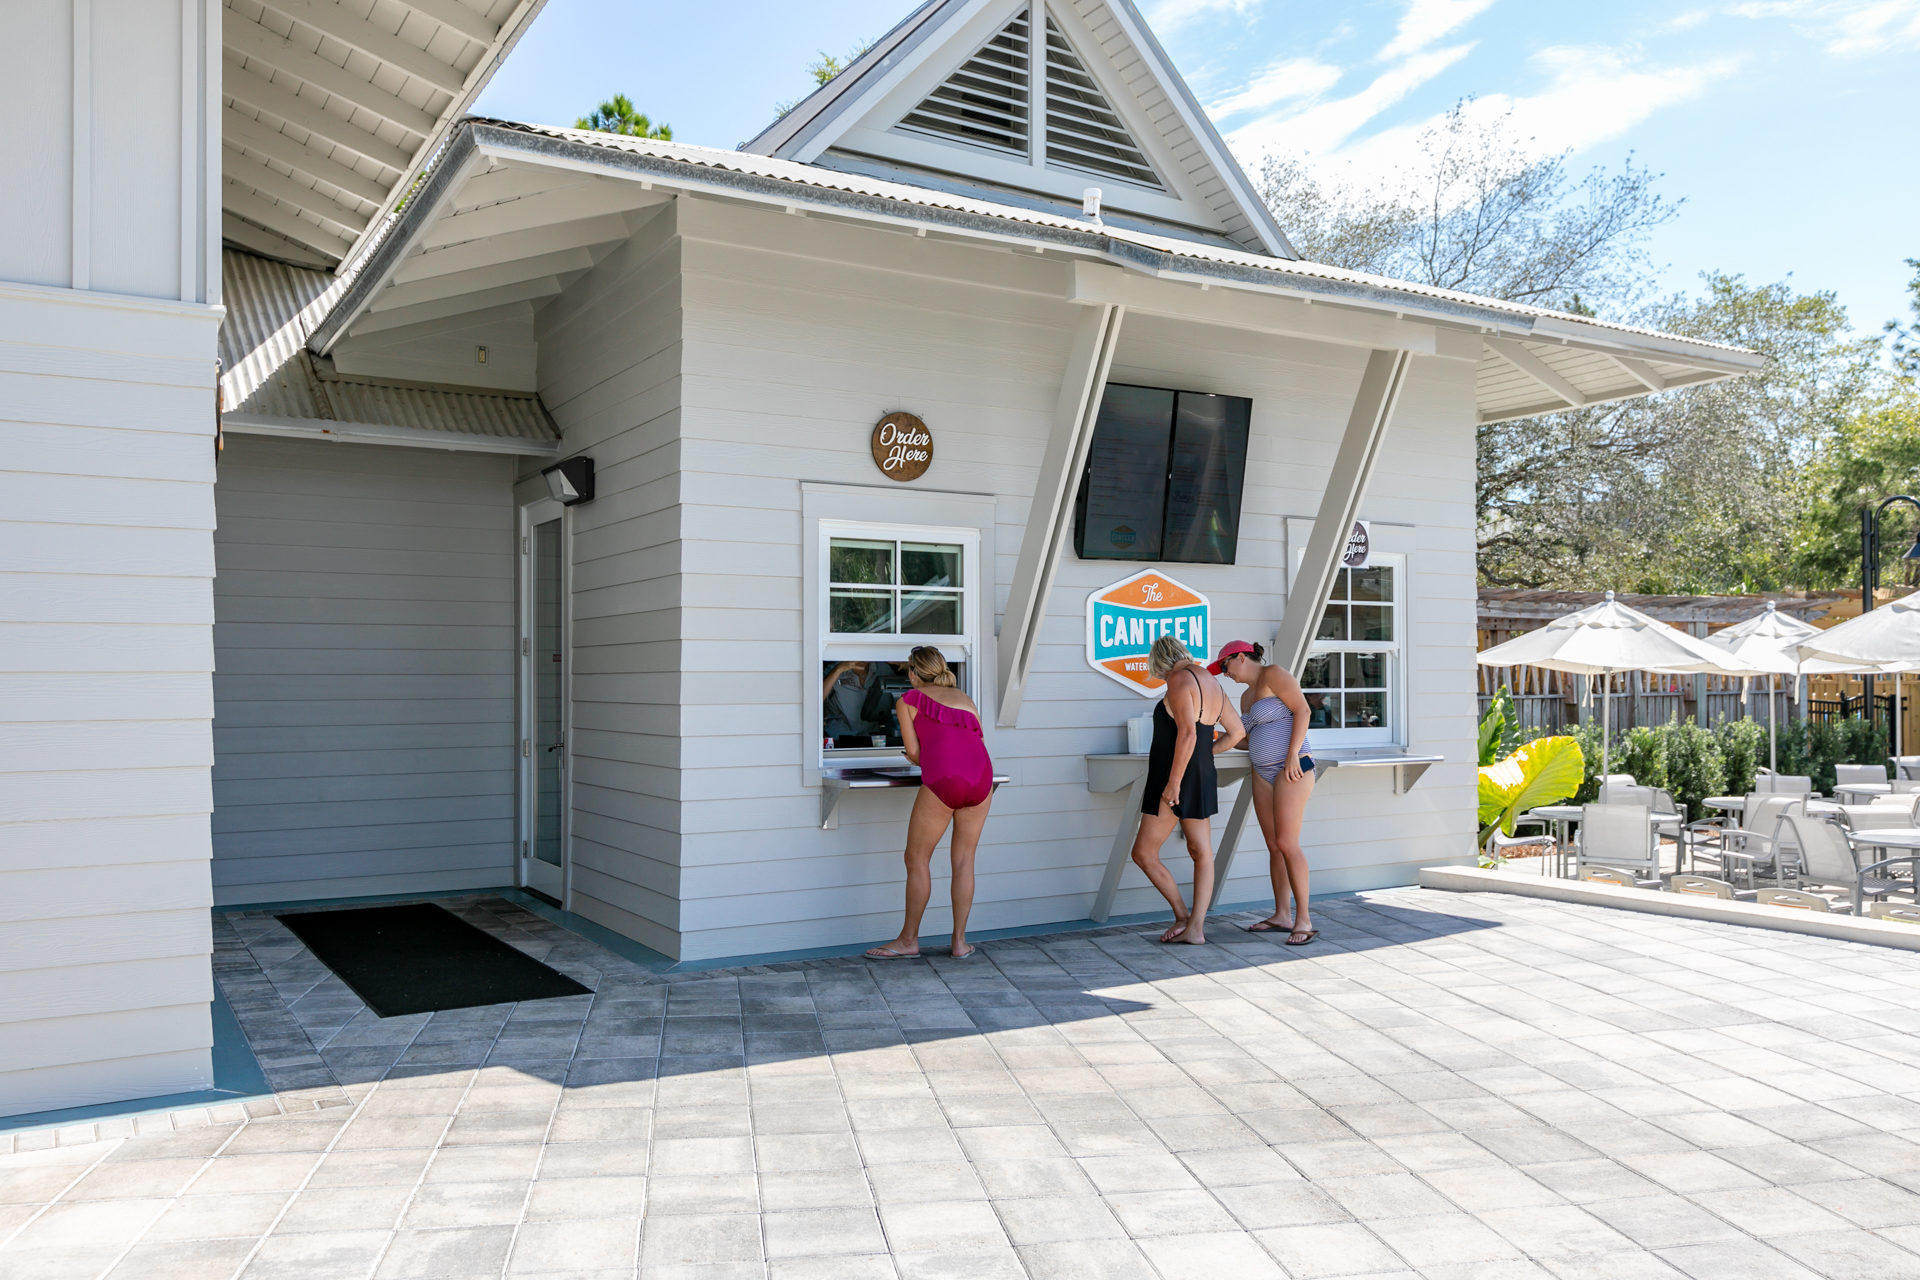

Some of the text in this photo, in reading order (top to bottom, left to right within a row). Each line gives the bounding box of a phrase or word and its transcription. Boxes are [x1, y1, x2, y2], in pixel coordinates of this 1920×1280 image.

[880, 423, 930, 446] Order
[883, 445, 928, 471] Here
[1343, 543, 1367, 561] Here
[1141, 582, 1163, 605] The
[1124, 662, 1150, 672] WATER
